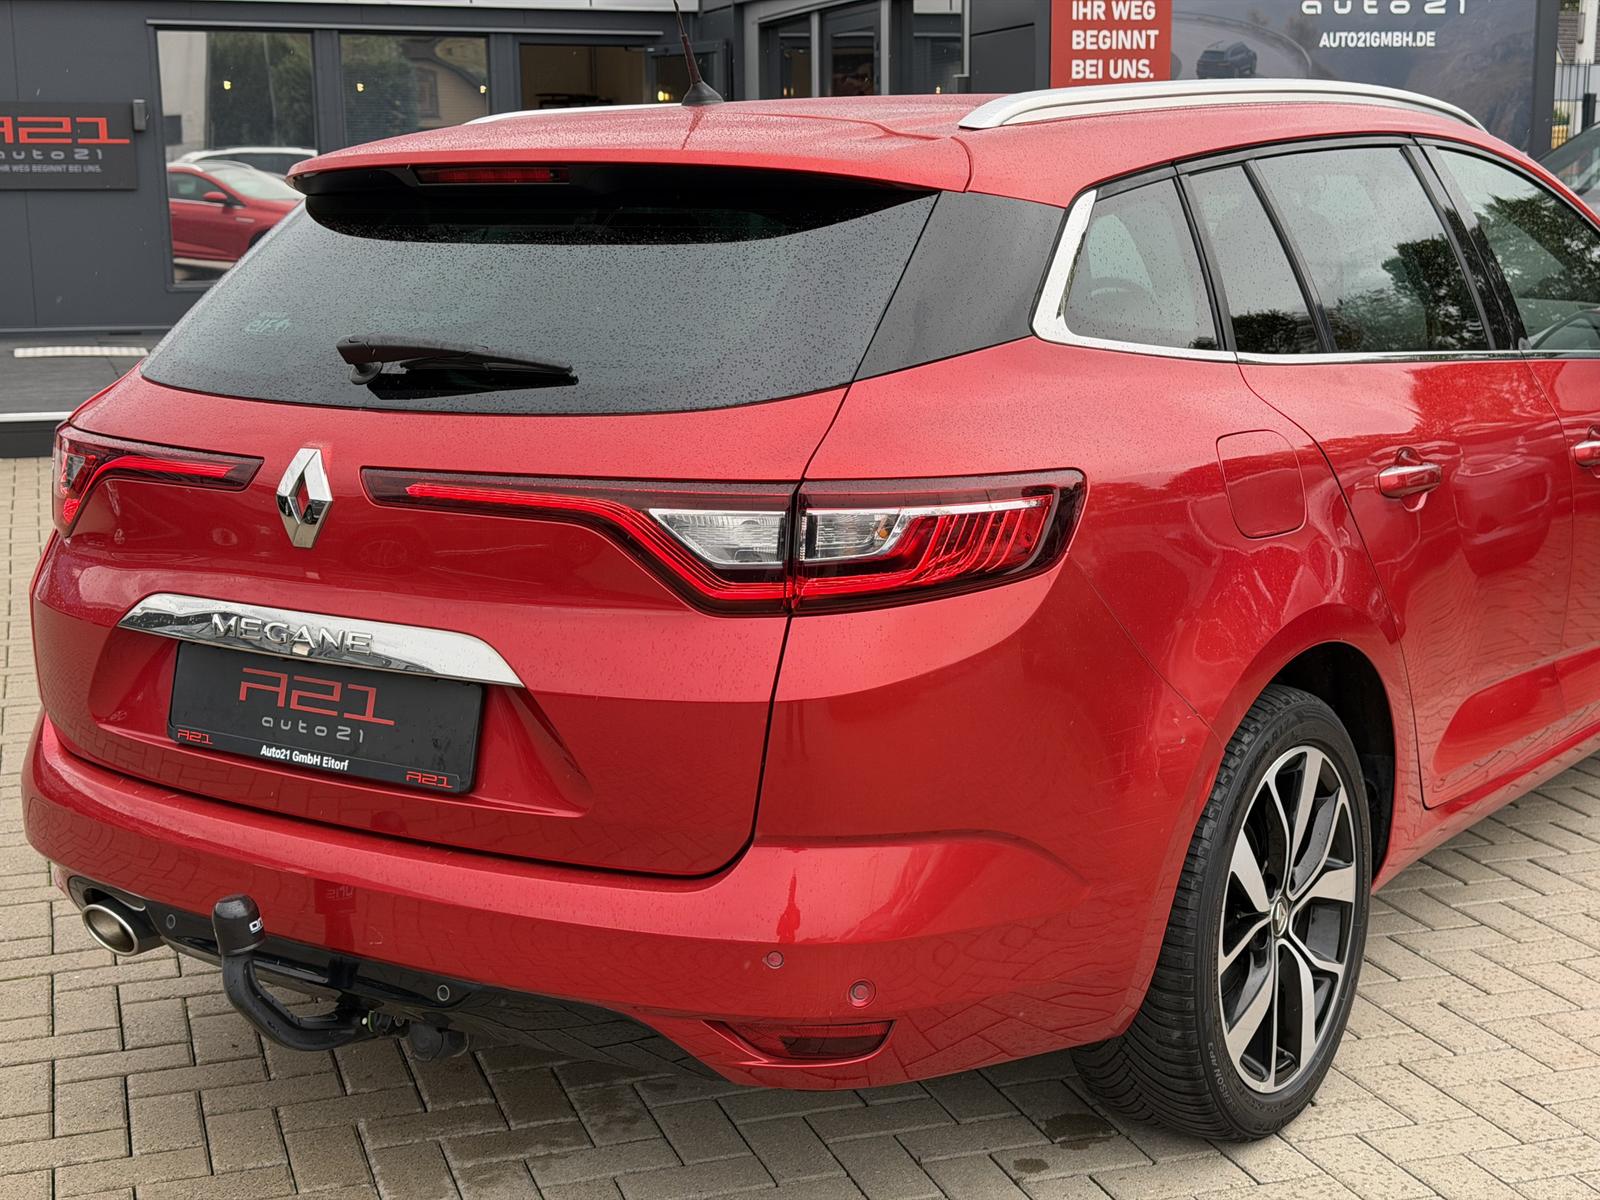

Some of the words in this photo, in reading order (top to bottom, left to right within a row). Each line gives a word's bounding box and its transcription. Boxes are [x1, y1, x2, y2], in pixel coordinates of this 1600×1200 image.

[1072, 0, 1106, 20] IHR
[1111, 0, 1156, 20] WEG
[1072, 29, 1160, 50] BEGINNT
[1319, 31, 1436, 48] AUTO21GMBH.DE
[1071, 59, 1104, 79] BEI
[1109, 58, 1154, 79] UNS.
[12, 164, 30, 173] WEG
[31, 164, 66, 173] BEGINNT
[68, 164, 82, 173] BEI
[211, 613, 373, 656] MEGANE
[239, 667, 396, 726] A21
[260, 745, 290, 760] Auto21
[292, 750, 321, 766] GmbH
[322, 756, 349, 771] Eitorf
